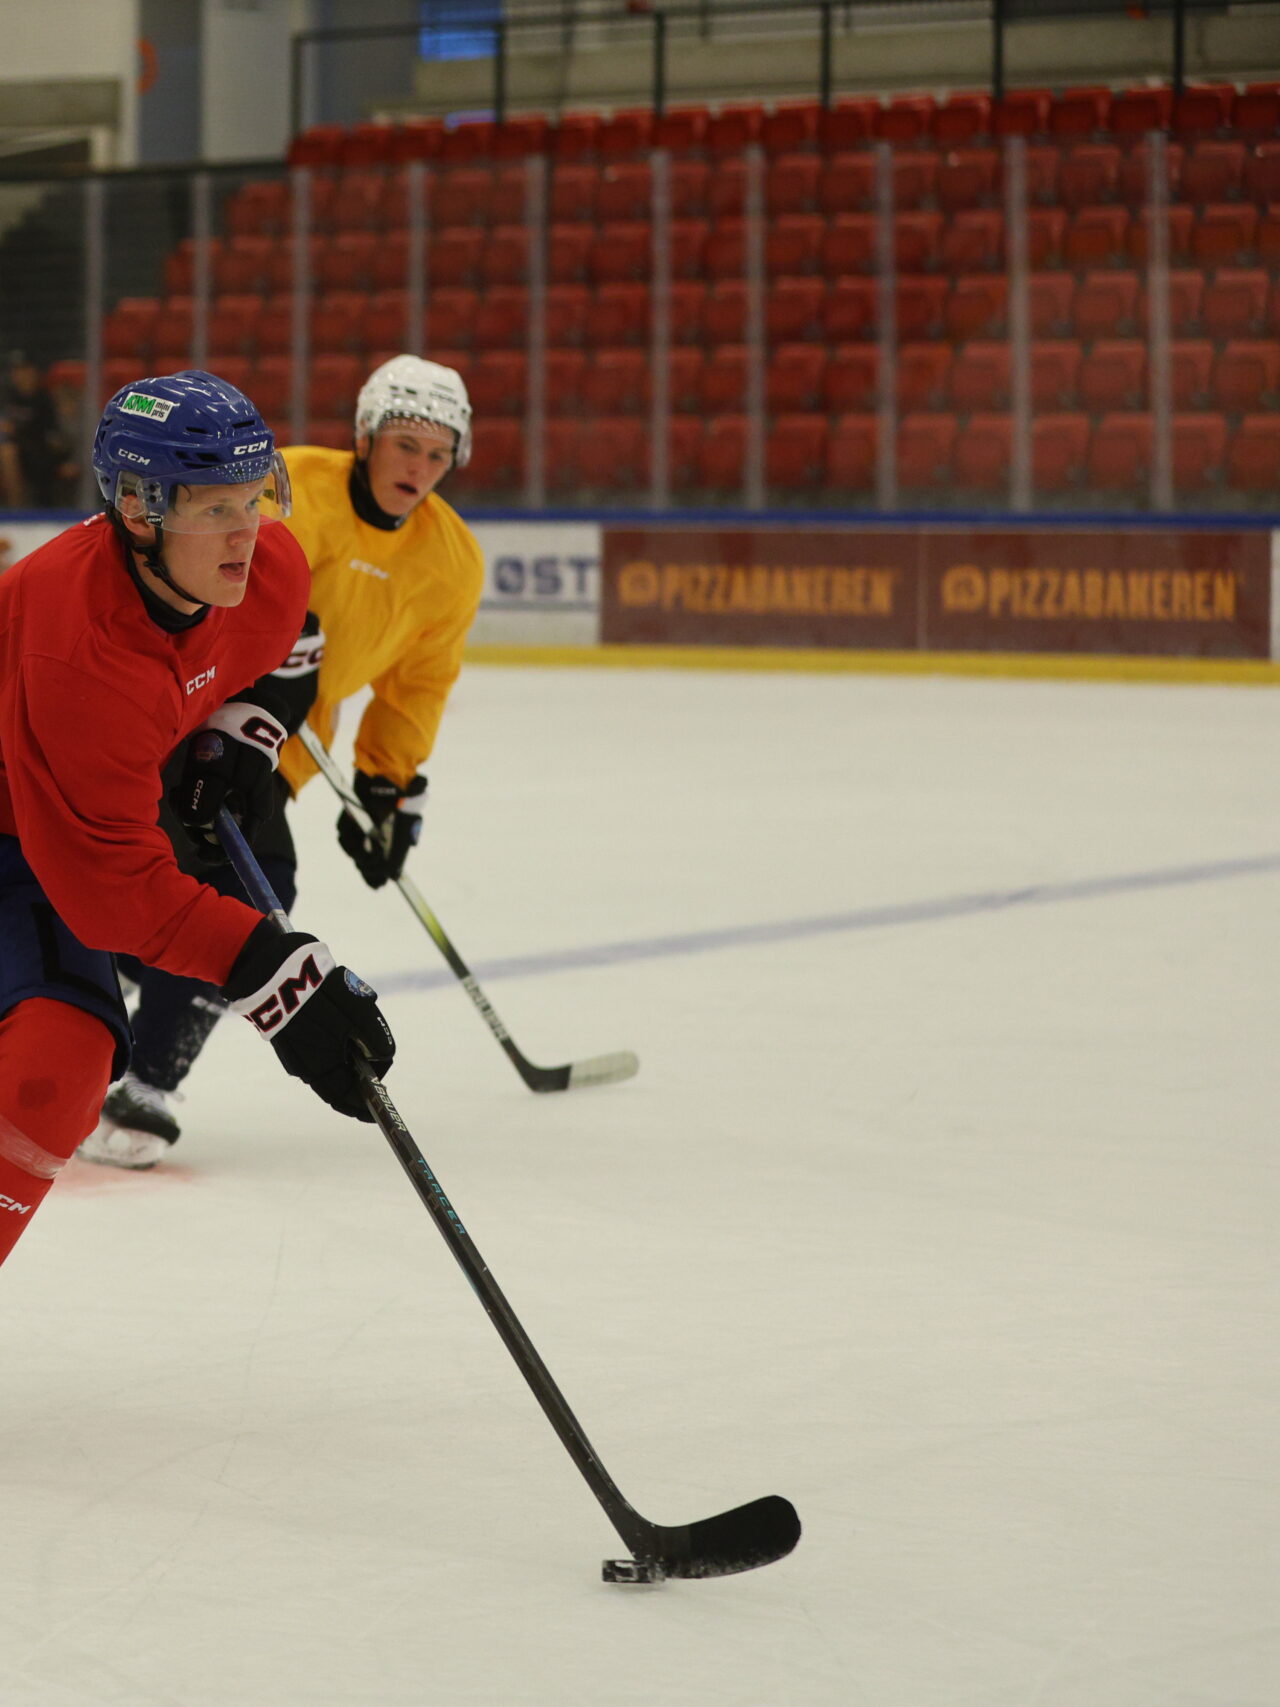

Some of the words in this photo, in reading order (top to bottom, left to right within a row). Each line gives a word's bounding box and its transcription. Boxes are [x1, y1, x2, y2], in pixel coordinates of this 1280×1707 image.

[123, 394, 157, 414] KIWI
[151, 409, 166, 418] pris
[155, 401, 171, 411] mini
[117, 448, 151, 466] CCM
[233, 439, 269, 455] CCM
[493, 554, 601, 596] ØST
[663, 563, 895, 617] PIZZABAKEREN
[987, 567, 1236, 622] PIZZABAKEREN
[185, 665, 217, 696] CCM
[191, 779, 204, 810] CCM
[377, 1016, 393, 1046] CCM
[375, 1085, 407, 1132] BAUER
